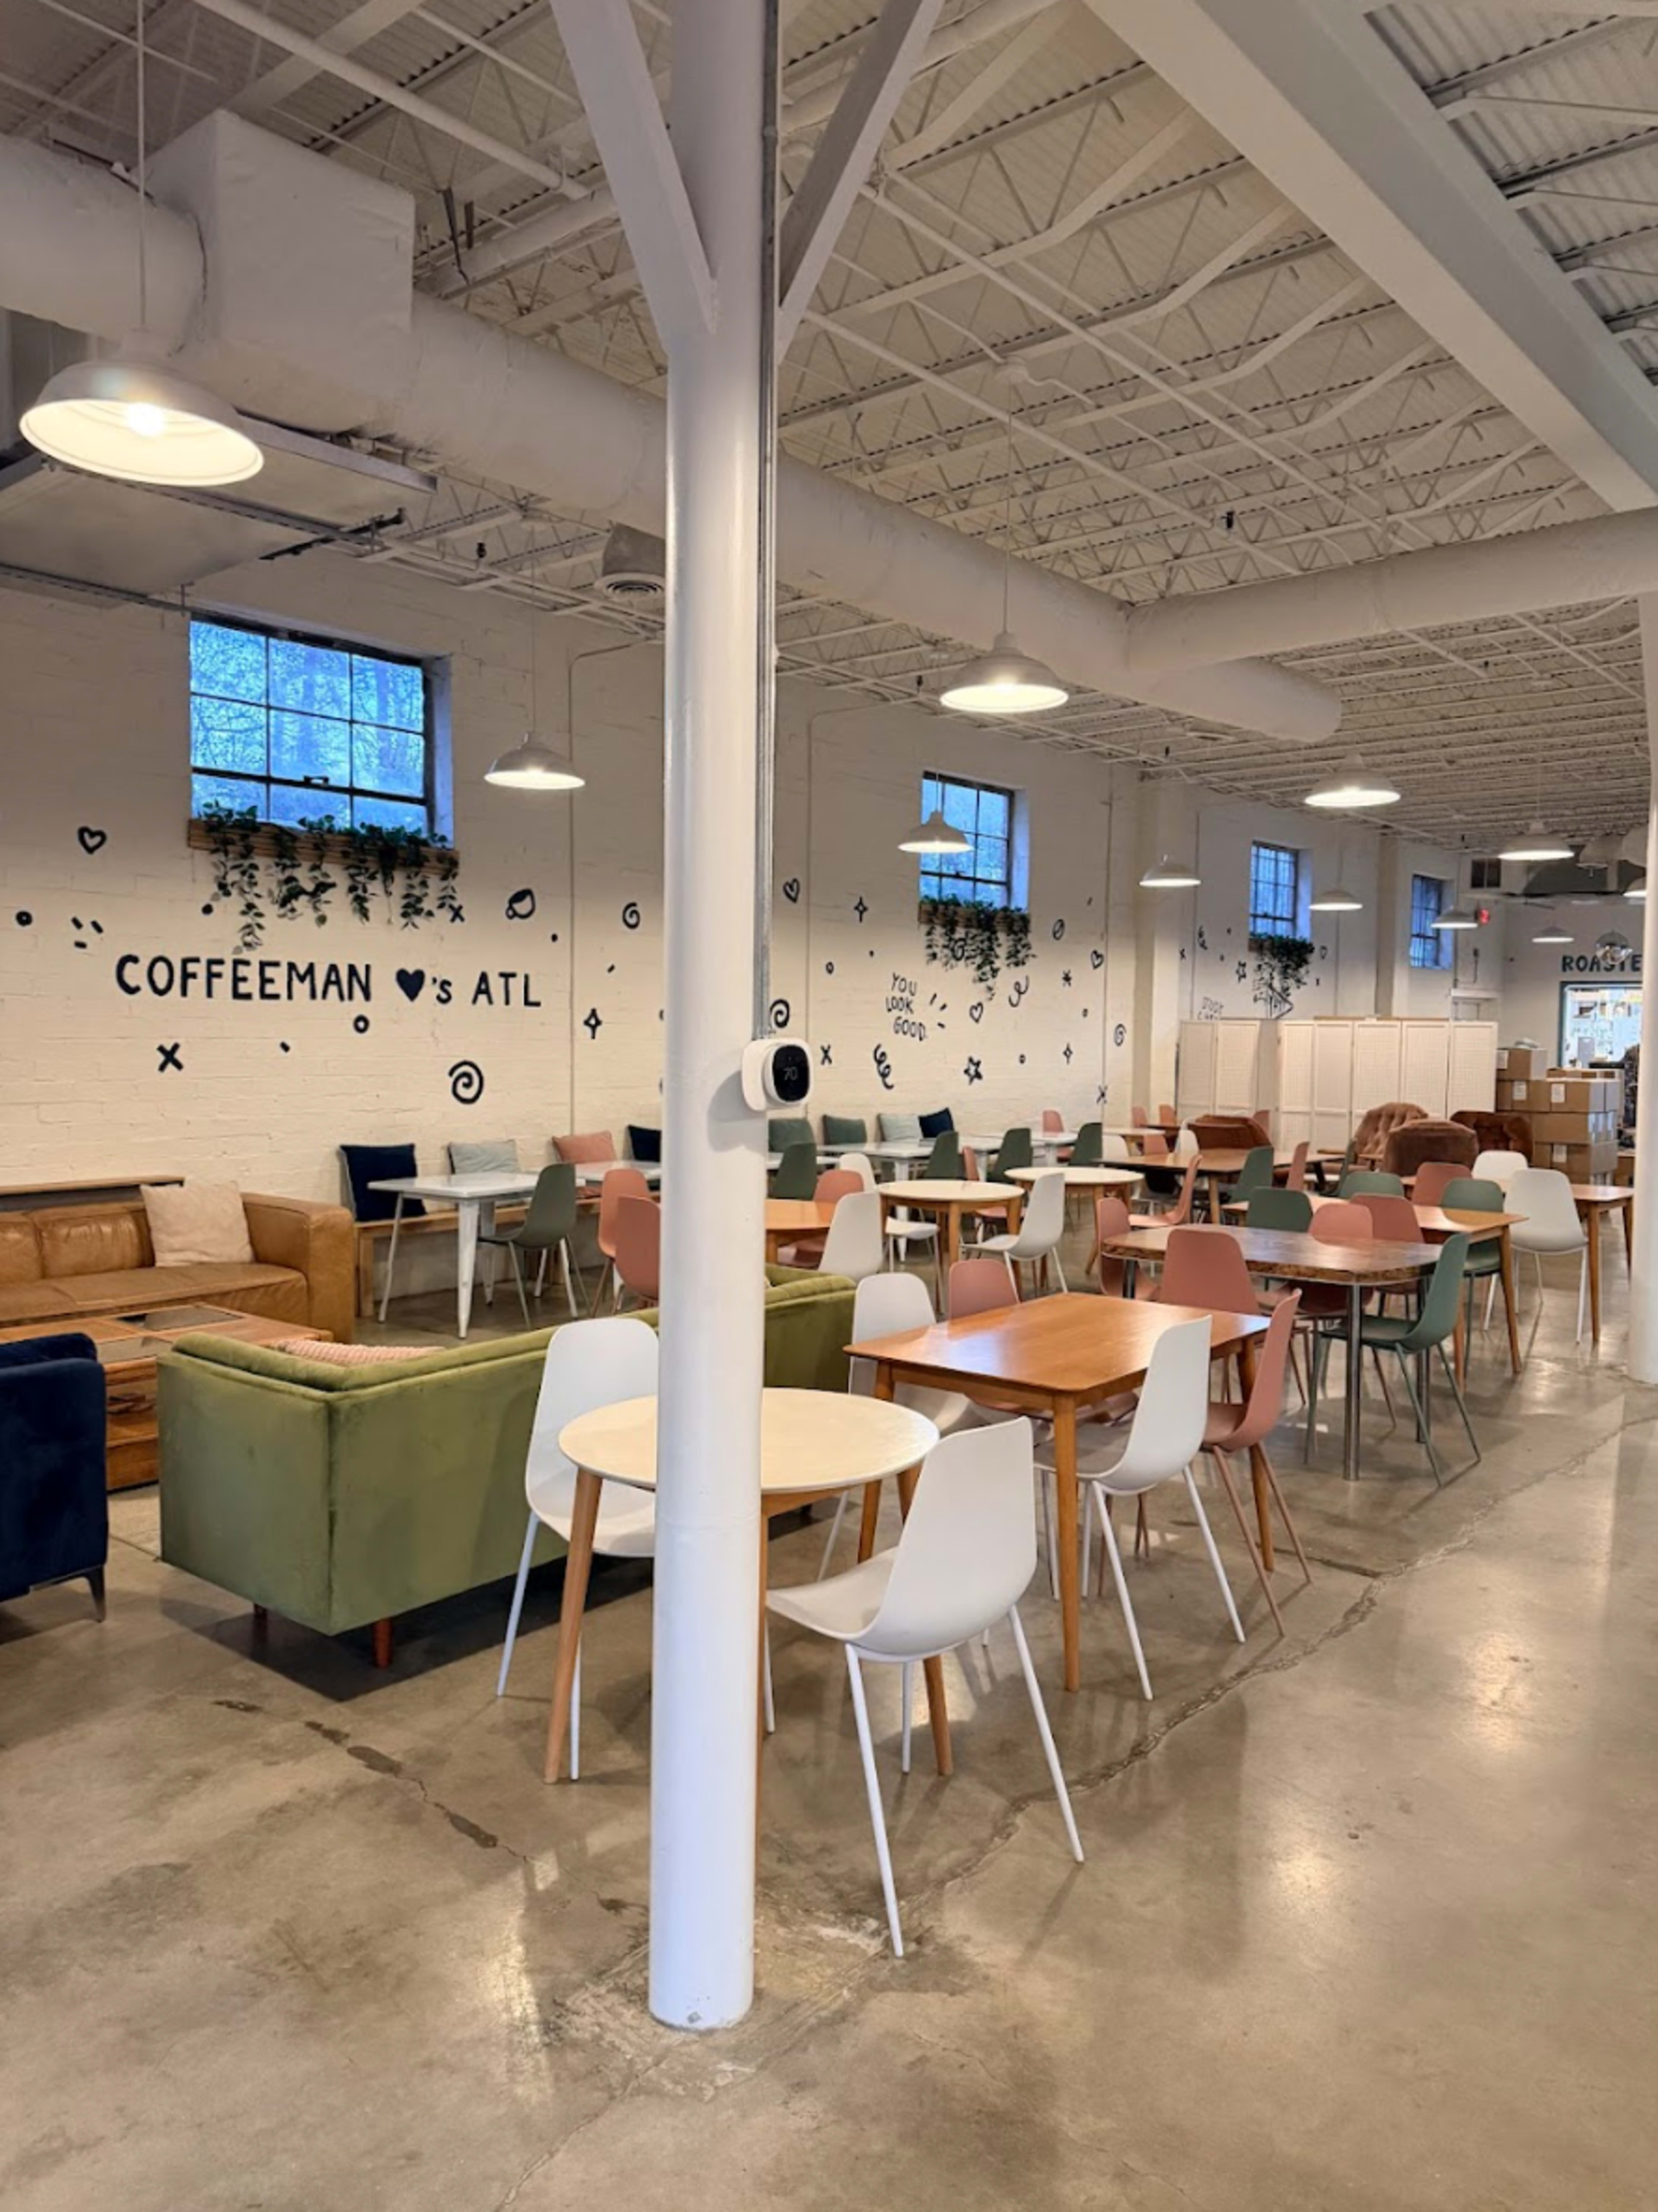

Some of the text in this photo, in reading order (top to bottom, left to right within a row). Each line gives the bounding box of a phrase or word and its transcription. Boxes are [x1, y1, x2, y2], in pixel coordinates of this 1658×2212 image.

[116, 954, 371, 1002] COFFEEMAN
[472, 971, 541, 1007] ATL
[891, 972, 917, 997] YOU
[886, 996, 914, 1014] LOOK
[893, 1016, 926, 1041] GOOD
[783, 1066, 797, 1080] 70
